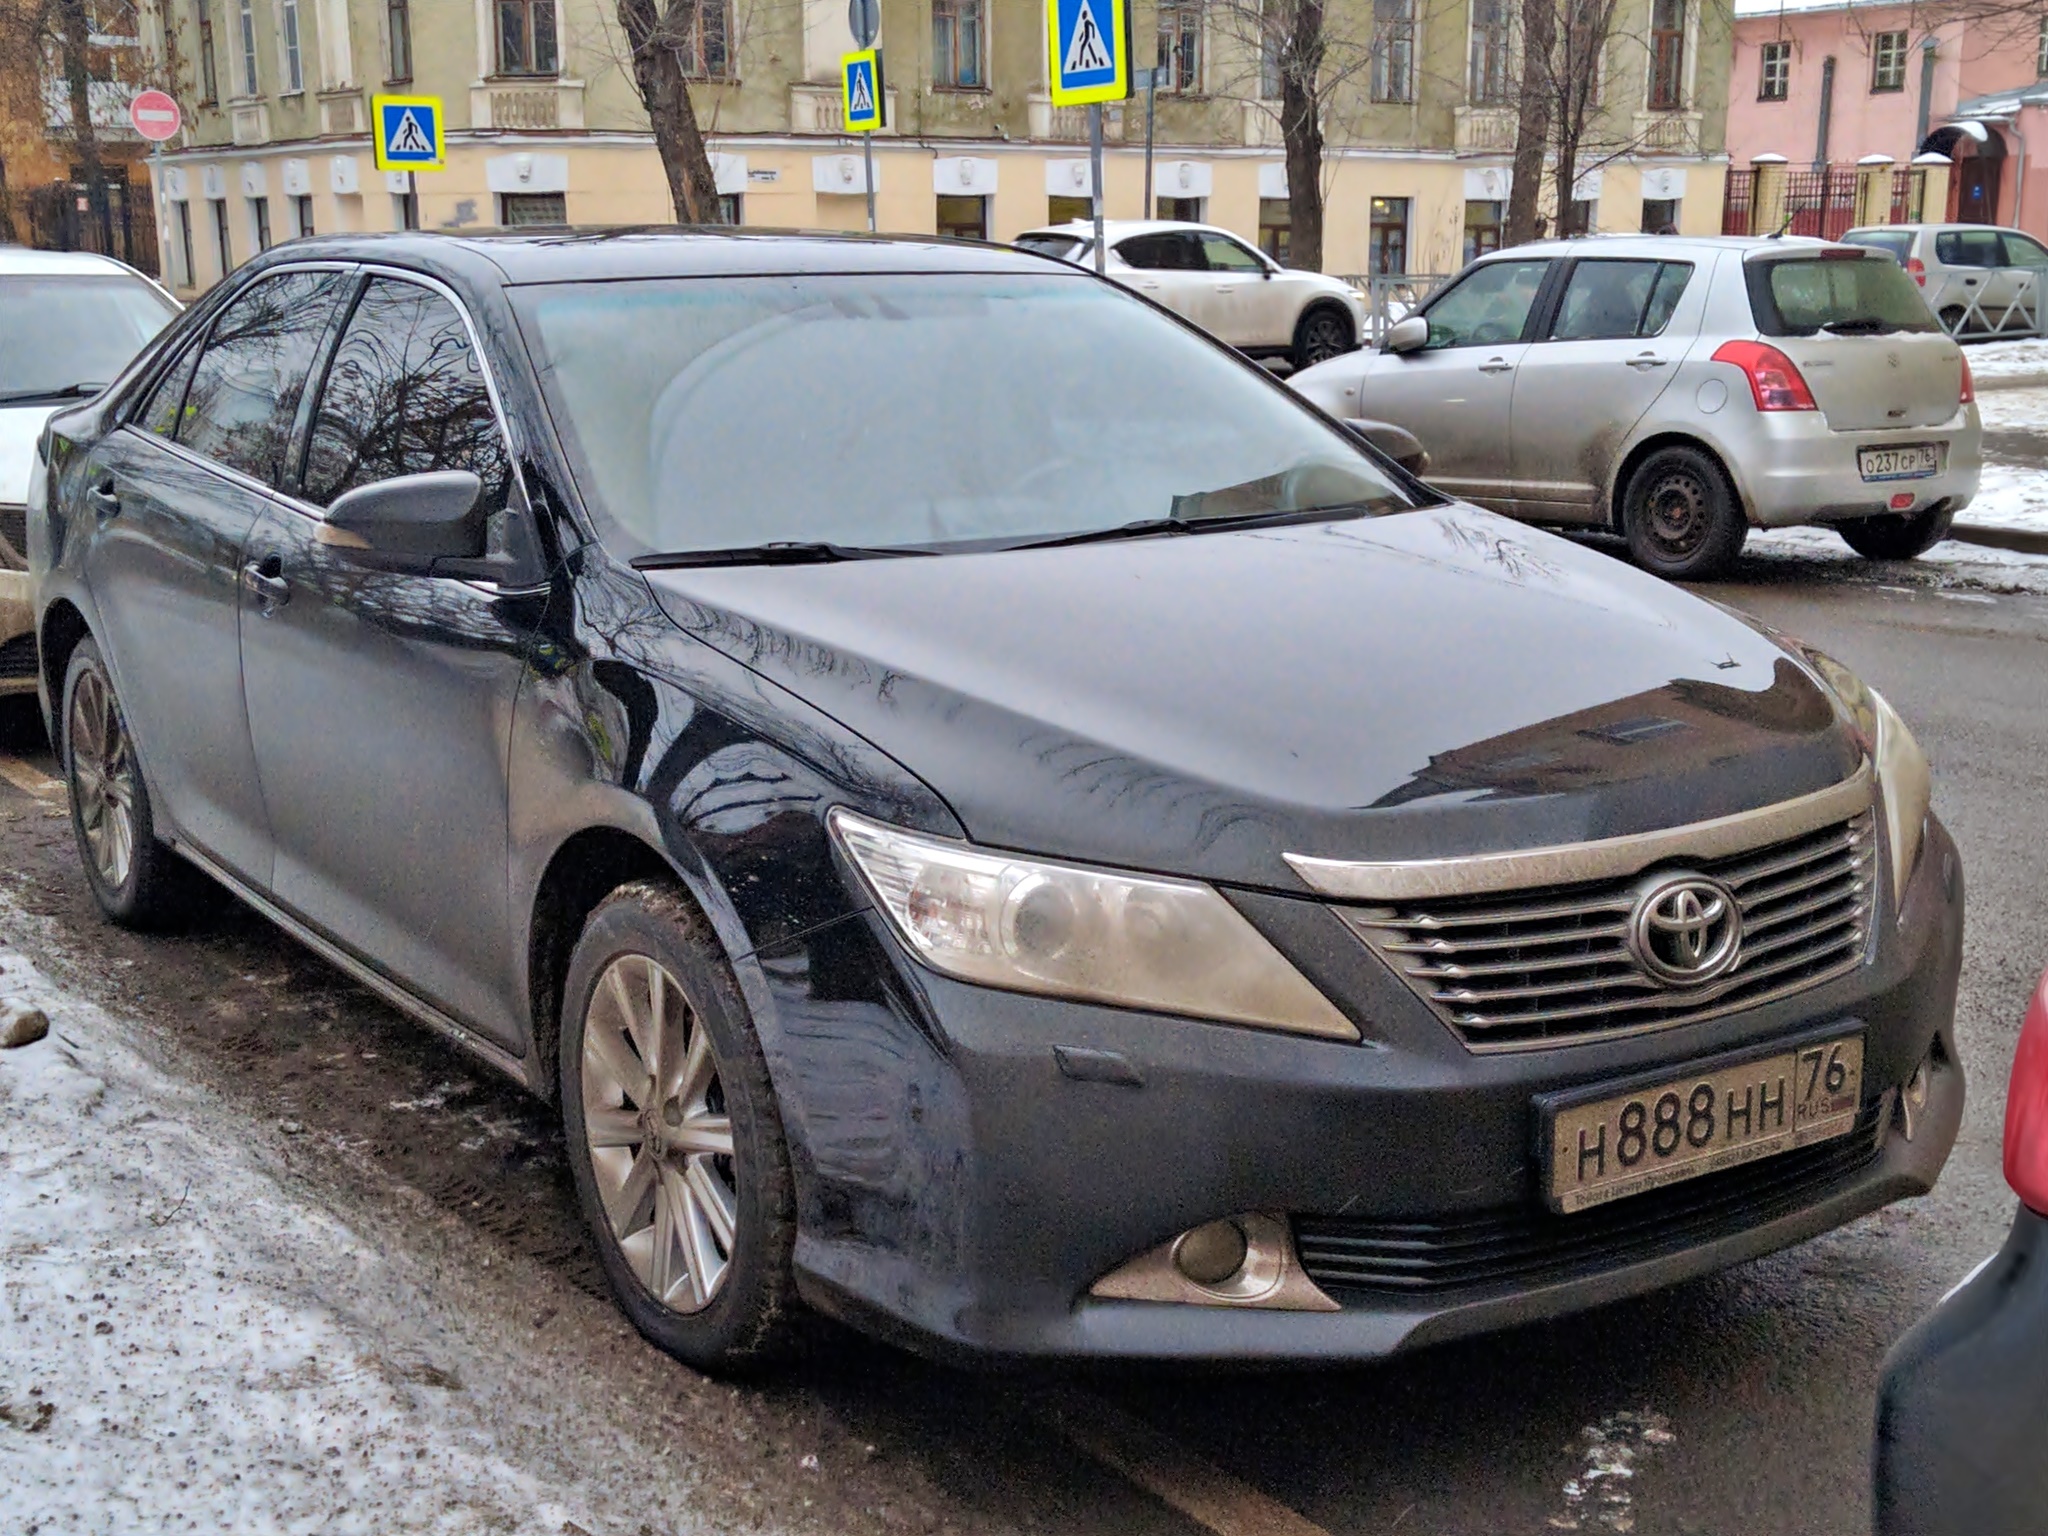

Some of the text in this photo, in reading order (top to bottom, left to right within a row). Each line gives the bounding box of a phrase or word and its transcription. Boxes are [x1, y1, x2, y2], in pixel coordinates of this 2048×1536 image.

[1866, 452, 1915, 473] О237СР
[1577, 1043, 1846, 1182] Н888НН 76
[1797, 1097, 1830, 1119] RUS
